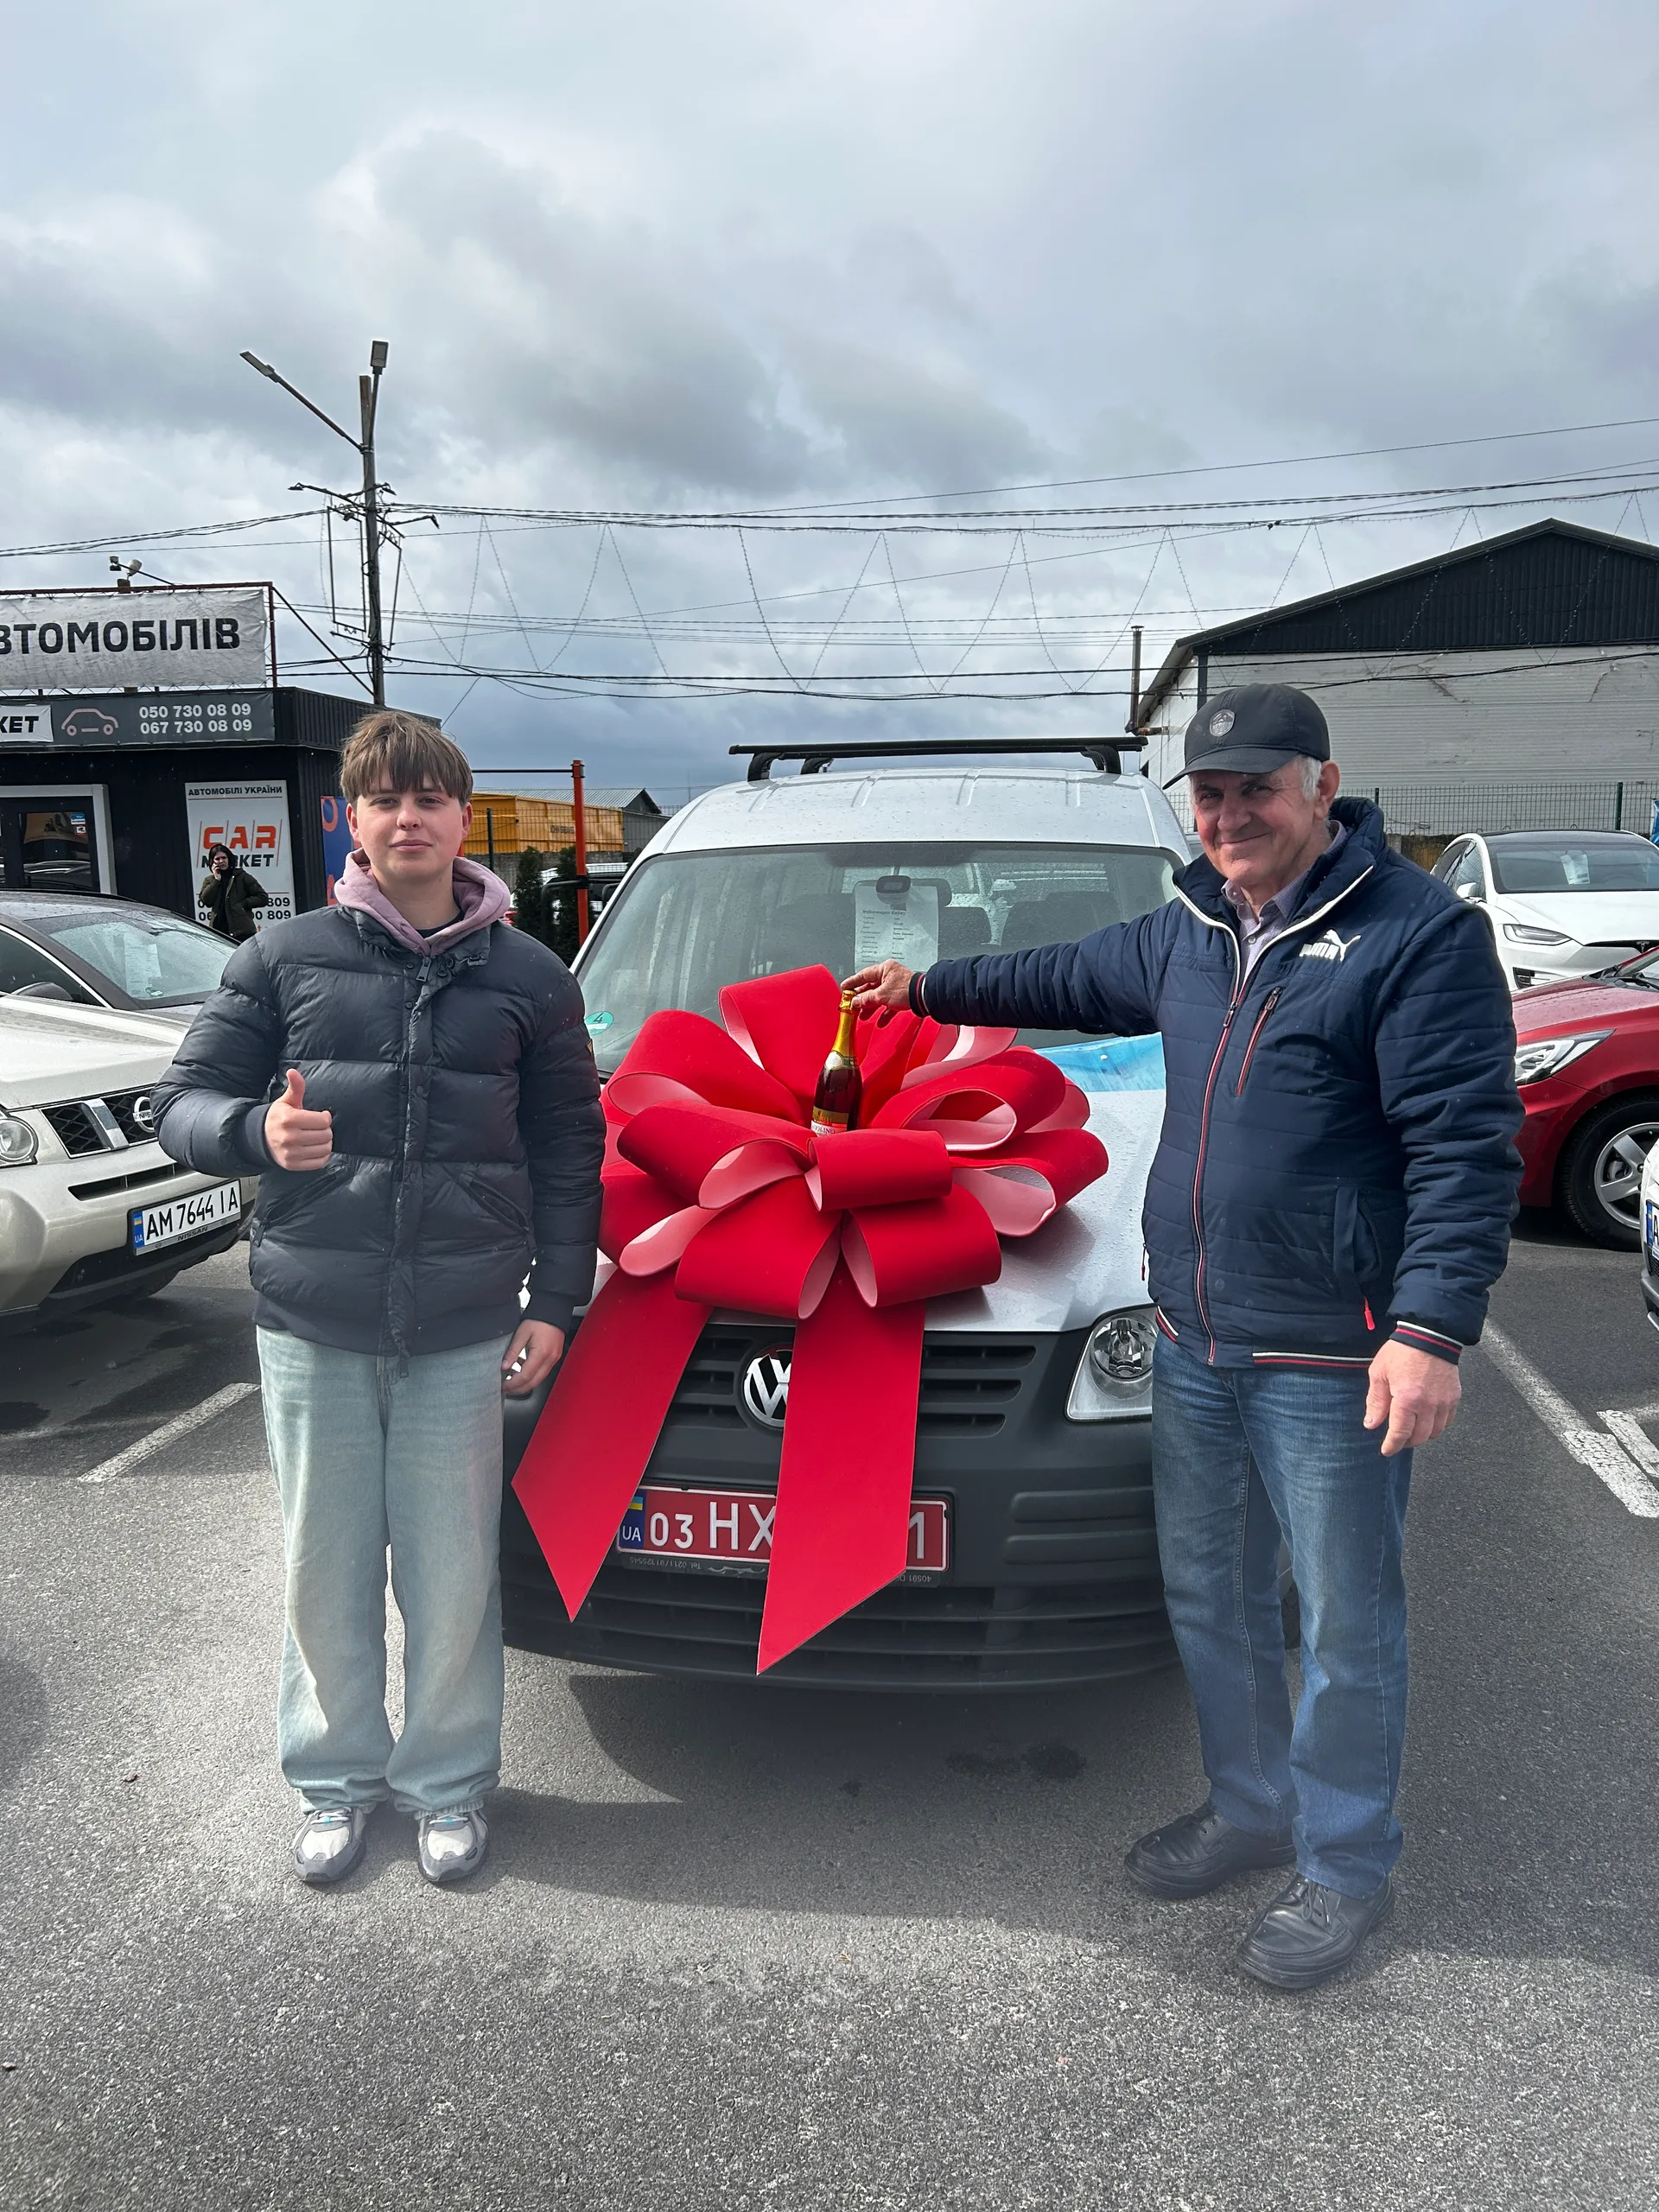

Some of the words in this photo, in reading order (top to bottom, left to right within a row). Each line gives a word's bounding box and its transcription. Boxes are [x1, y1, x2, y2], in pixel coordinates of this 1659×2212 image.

[139, 705, 168, 719] 050
[173, 704, 203, 718] 730
[207, 703, 227, 716] 08
[231, 702, 251, 715] 09
[140, 721, 169, 734] 067
[174, 720, 204, 734] 730
[207, 719, 228, 732] 08
[232, 718, 252, 732] 09
[188, 786, 243, 796] АВТОМОБІЛІ
[245, 785, 283, 795] УКРАЇНИ
[201, 854, 274, 868] MKET
[267, 910, 291, 920] 809
[594, 1012, 604, 1024] 4
[146, 1208, 173, 1240] AM
[176, 1194, 213, 1229] 7644
[135, 1234, 143, 1243] UA
[177, 1227, 208, 1242] NISSAN
[622, 1526, 641, 1541] UA
[650, 1512, 694, 1549] 03
[709, 1502, 776, 1551] HX
[908, 1511, 925, 1560] 1
